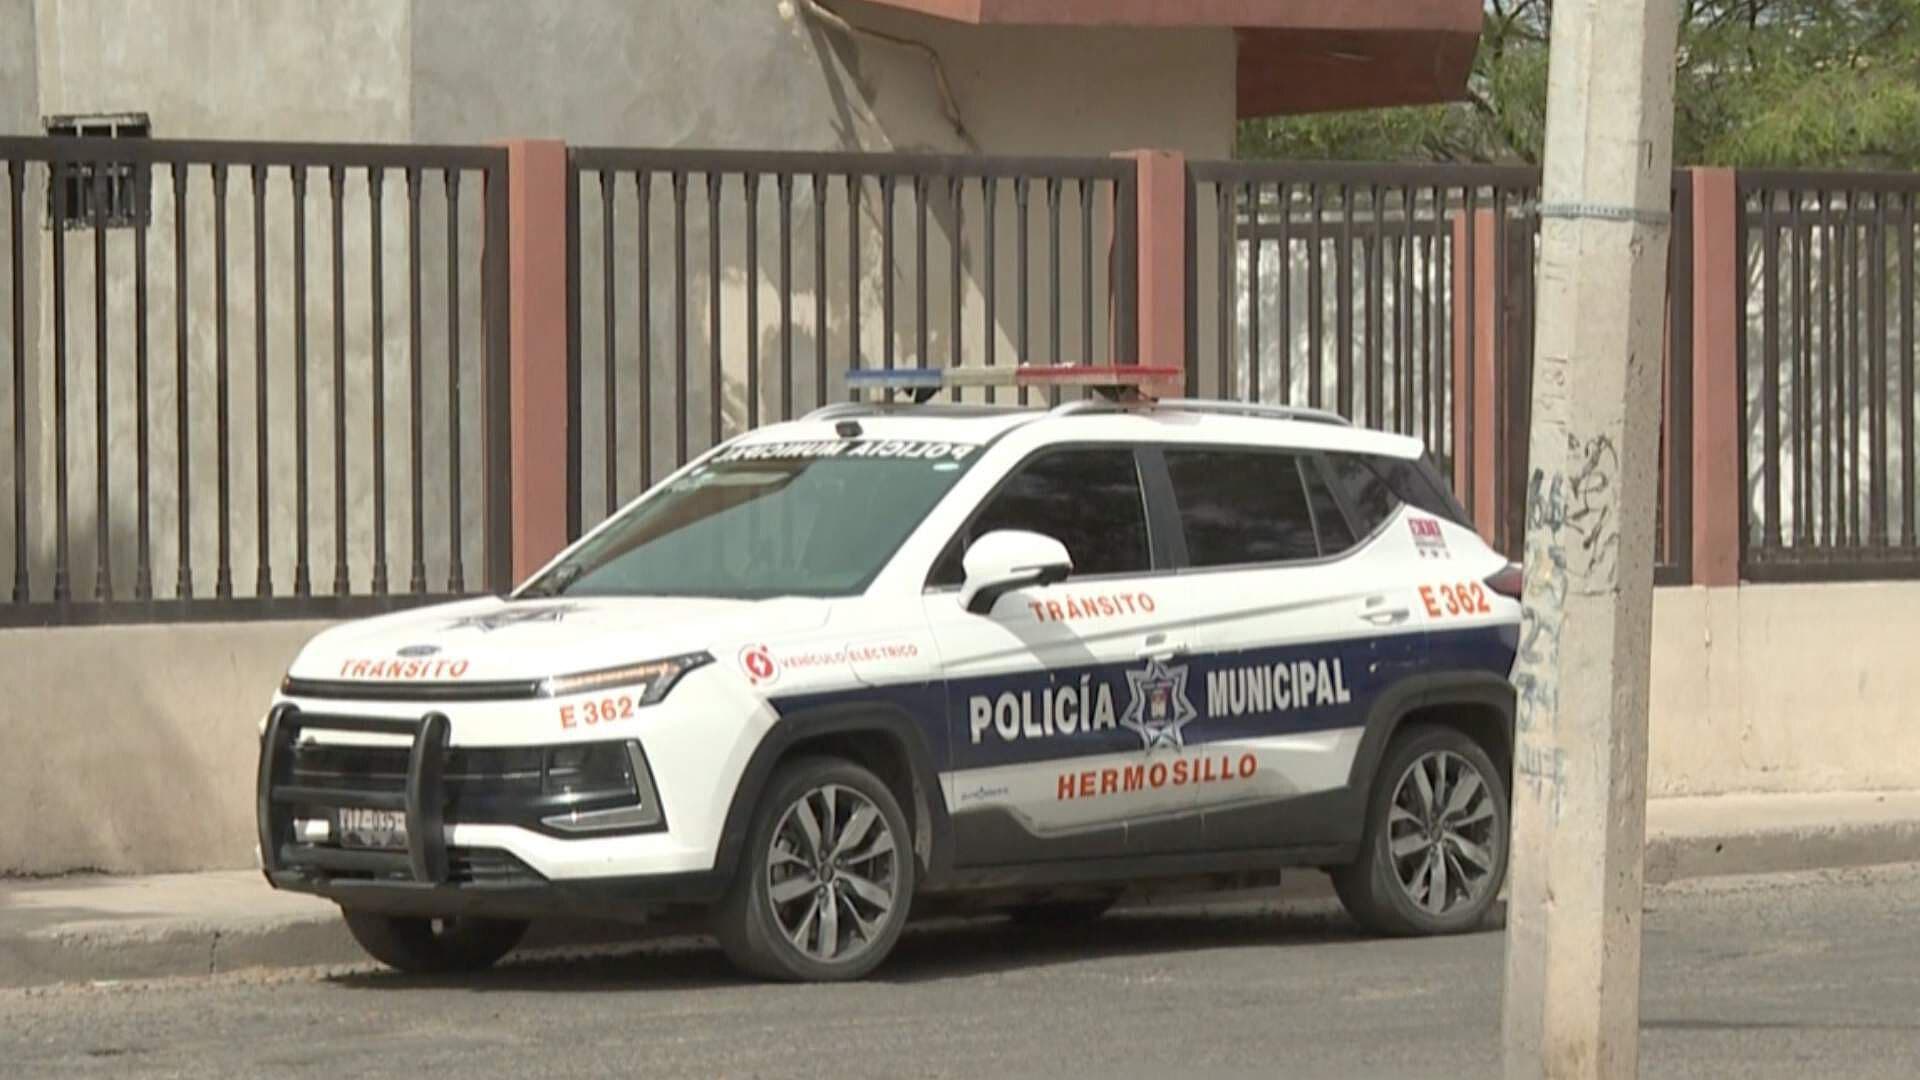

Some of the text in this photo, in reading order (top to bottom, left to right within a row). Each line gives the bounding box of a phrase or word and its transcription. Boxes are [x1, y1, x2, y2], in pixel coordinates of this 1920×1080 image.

[1418, 579, 1490, 617] E 362
[560, 696, 635, 729] E 362
[969, 658, 1351, 744] POLICÍA MUNICIPAL
[1057, 752, 1258, 801] HERMOSILLO
